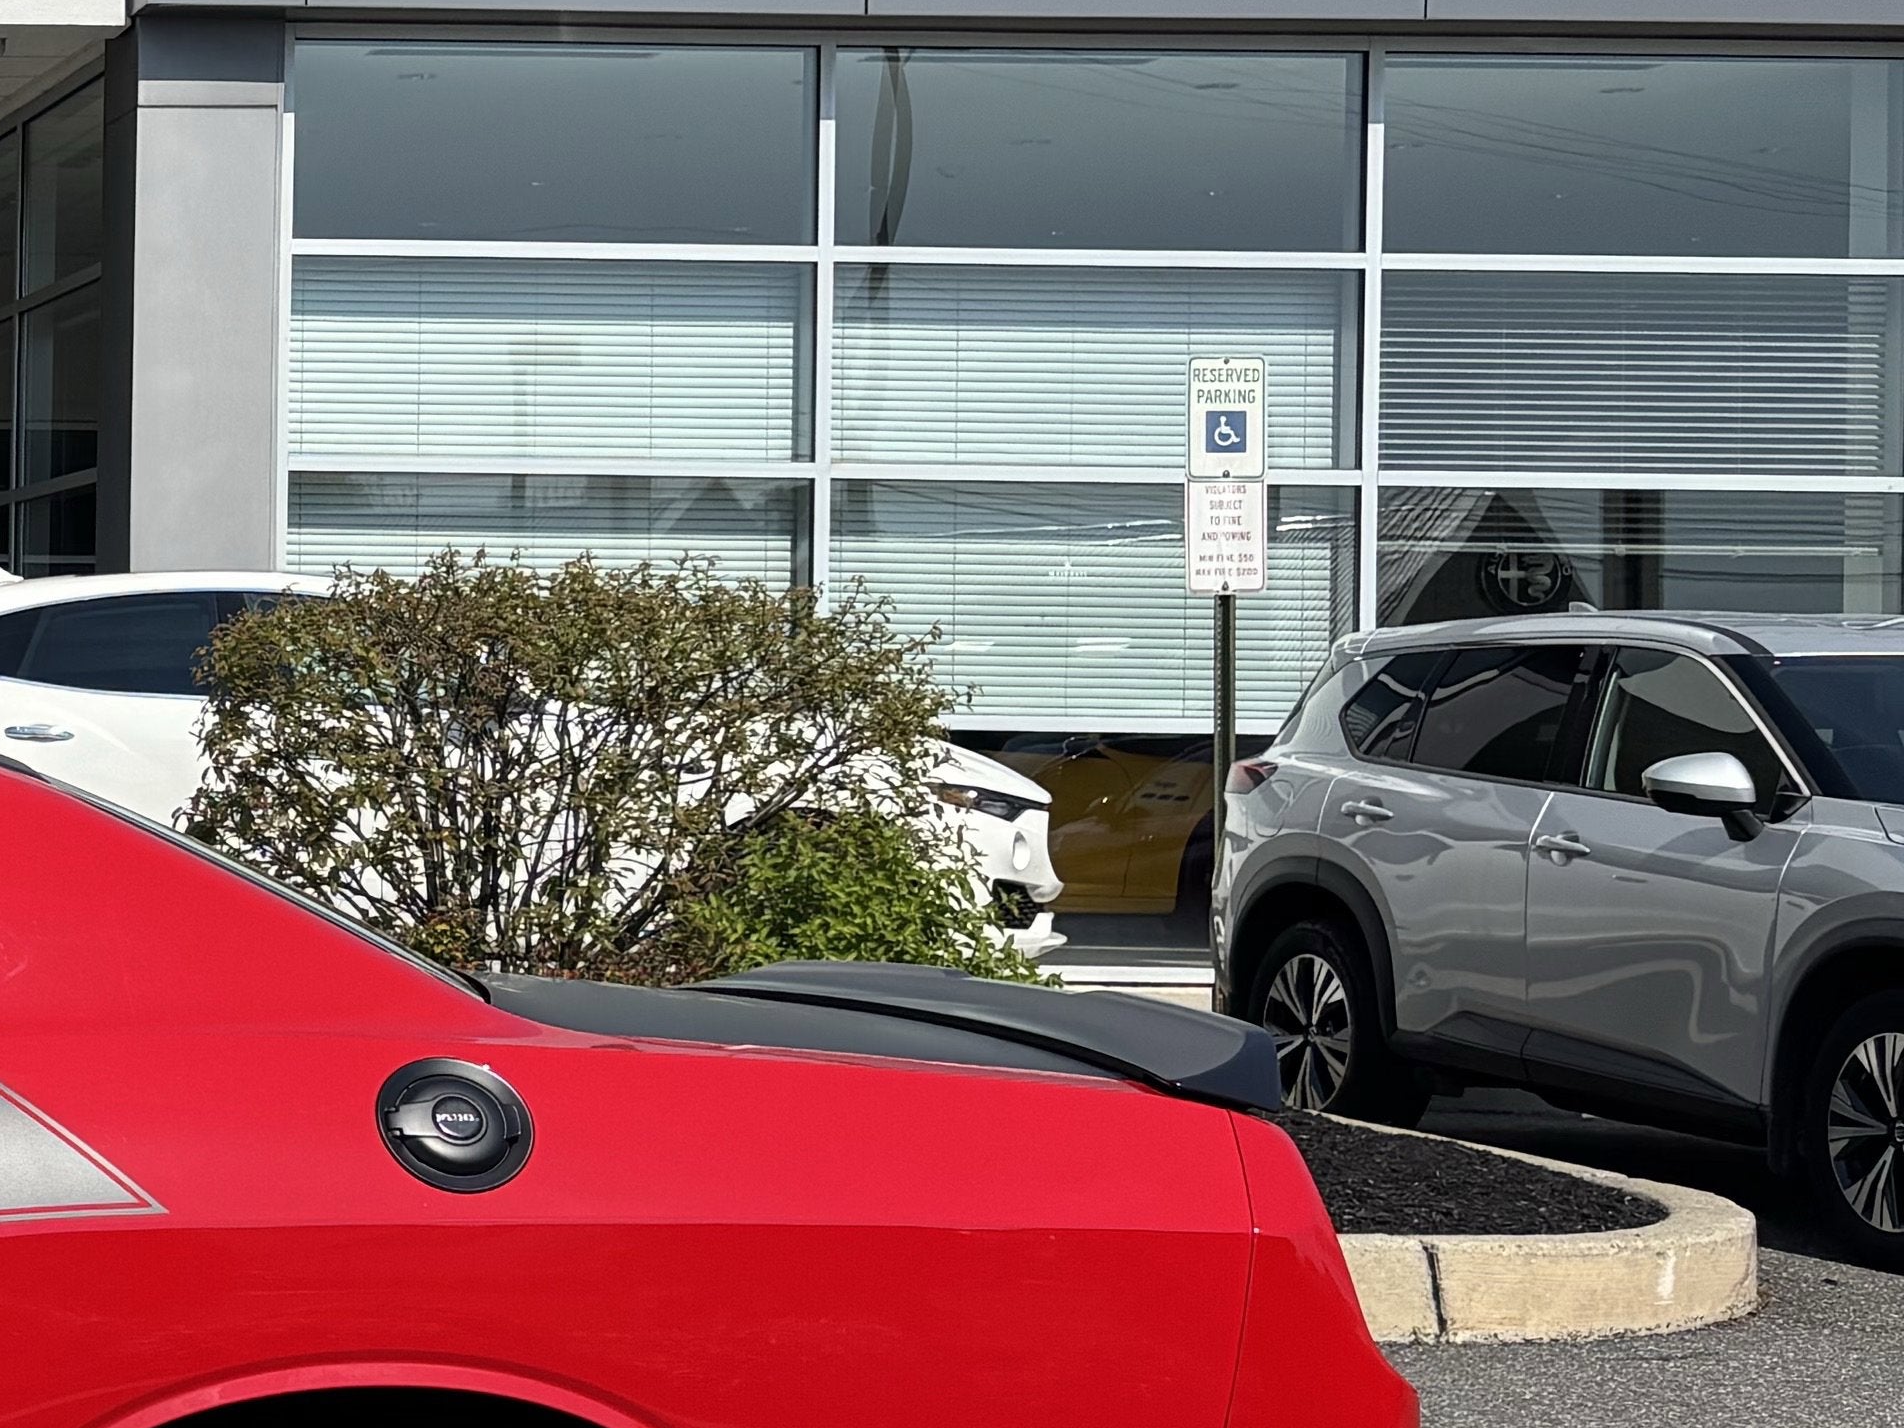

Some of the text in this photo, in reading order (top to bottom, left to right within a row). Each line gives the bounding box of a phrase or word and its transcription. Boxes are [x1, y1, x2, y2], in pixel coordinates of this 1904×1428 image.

[1192, 367, 1261, 383] RESERVED
[1196, 389, 1256, 404] PARKING
[1210, 516, 1243, 526] TO FINE
[1201, 532, 1219, 541] AND
